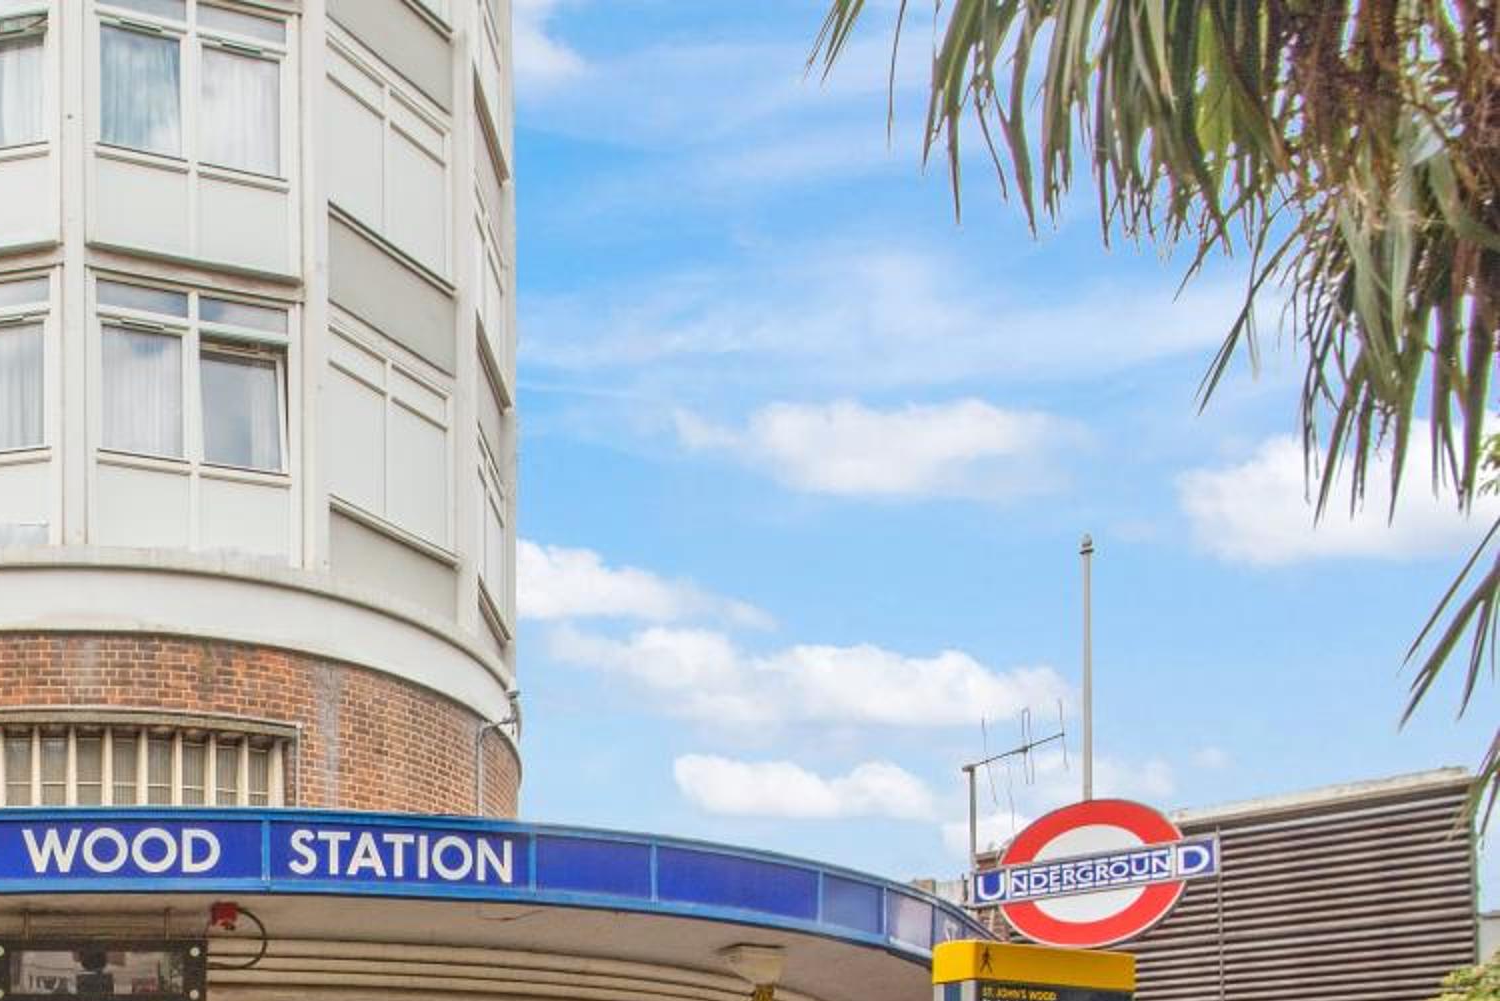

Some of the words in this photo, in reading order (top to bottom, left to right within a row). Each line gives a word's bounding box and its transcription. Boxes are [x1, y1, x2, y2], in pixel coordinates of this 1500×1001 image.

[22, 828, 221, 874] WOOD
[288, 829, 514, 883] STATION
[976, 845, 1211, 901] UNDERGROUND
